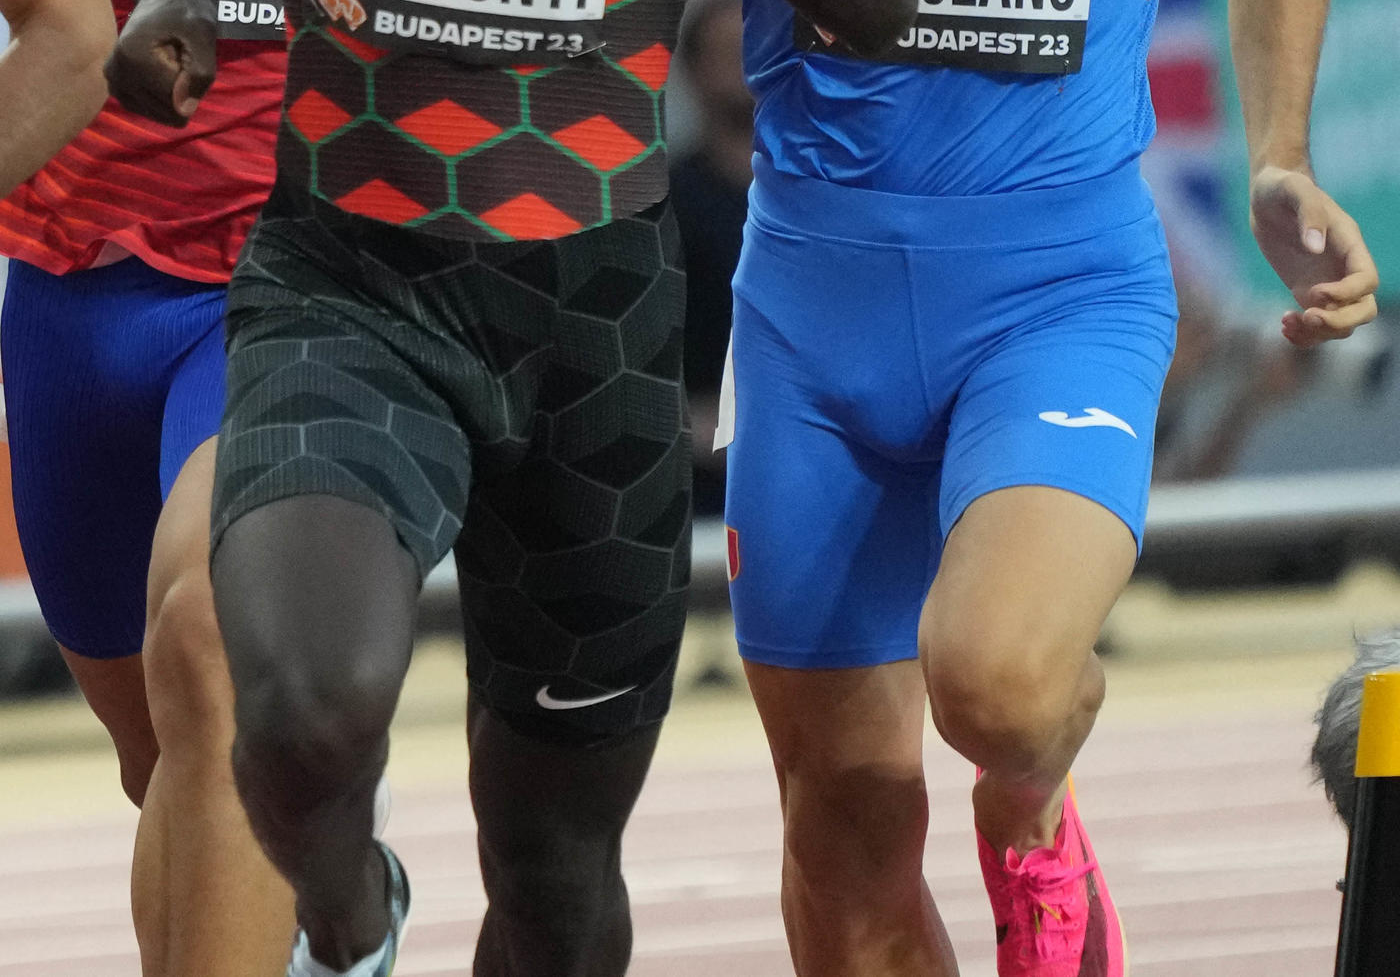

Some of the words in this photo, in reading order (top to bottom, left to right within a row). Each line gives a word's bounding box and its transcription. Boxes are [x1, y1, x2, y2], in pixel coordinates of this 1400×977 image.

[374, 10, 544, 52] BUDAPEST
[546, 33, 584, 53] 23
[897, 28, 1035, 55] UDAPEST
[1039, 34, 1070, 55] 23
